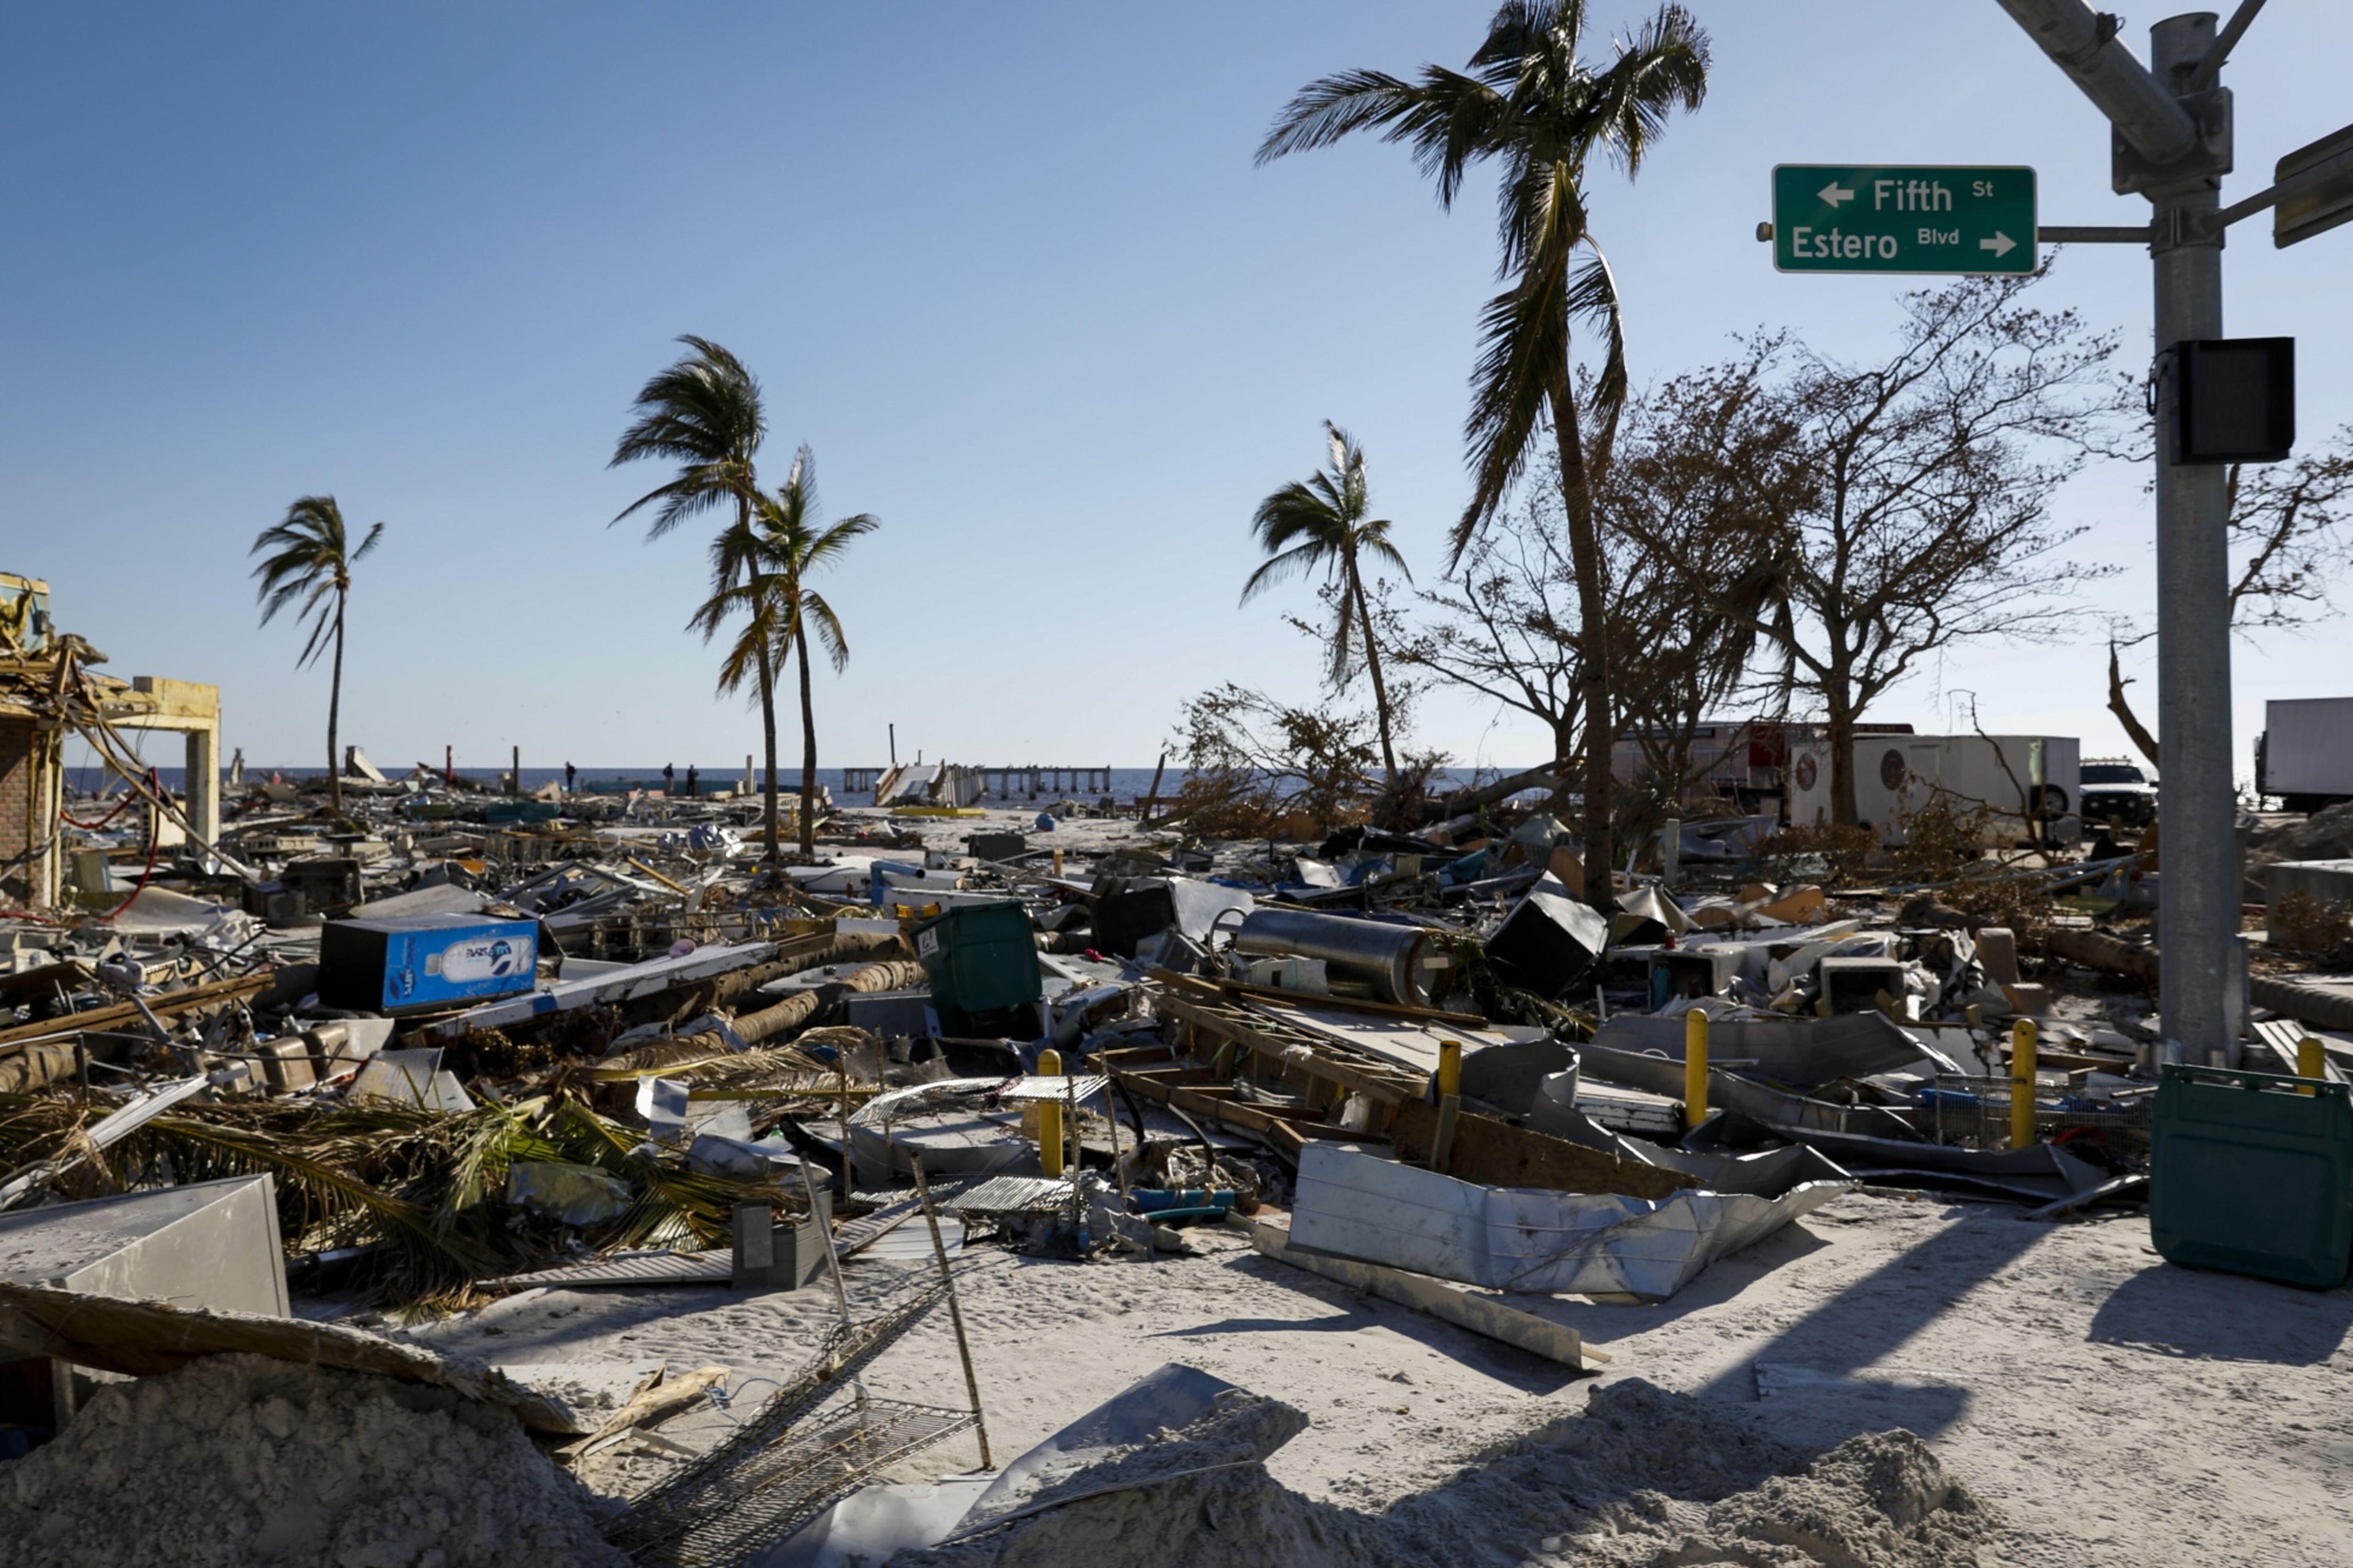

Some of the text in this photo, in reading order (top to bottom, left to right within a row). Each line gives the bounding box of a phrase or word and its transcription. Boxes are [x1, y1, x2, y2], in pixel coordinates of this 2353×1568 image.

[1875, 180, 1993, 211] Fifth St
[1793, 227, 1959, 258] Estero Blvd
